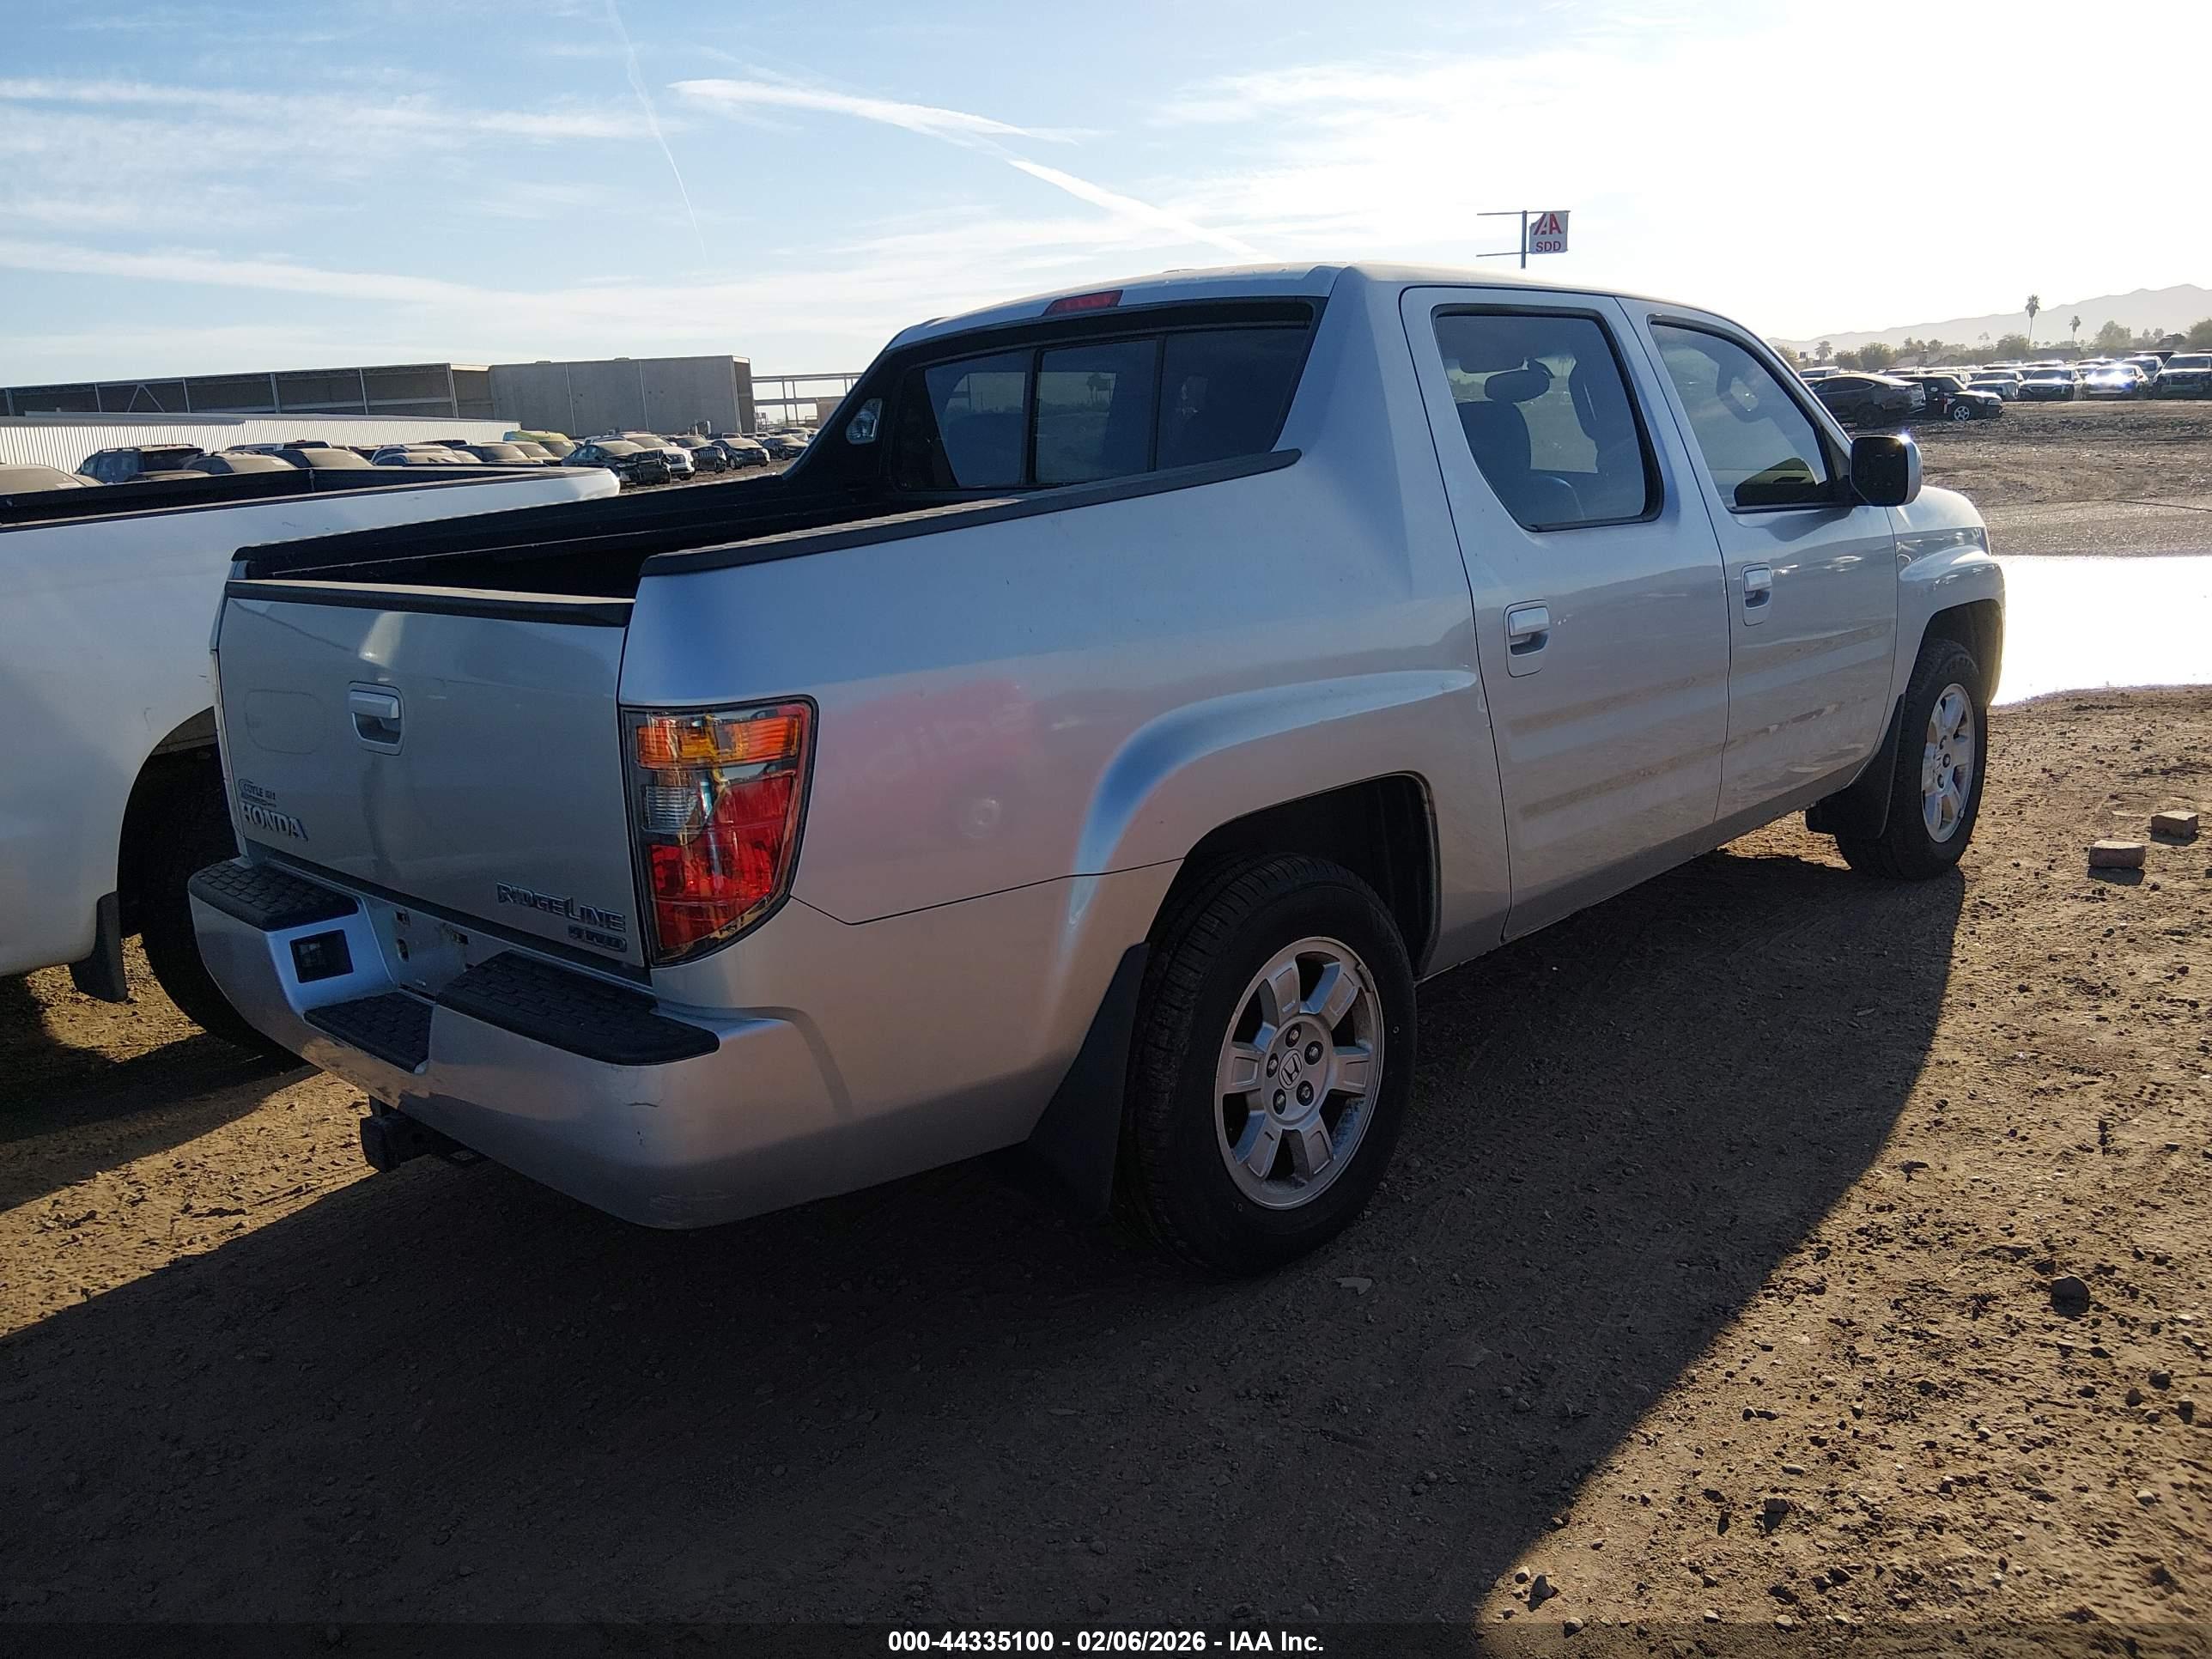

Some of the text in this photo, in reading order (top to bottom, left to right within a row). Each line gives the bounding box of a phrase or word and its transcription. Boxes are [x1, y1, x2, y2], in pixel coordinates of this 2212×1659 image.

[1535, 240, 1561, 252] SDD
[240, 801, 308, 842] HONDA
[495, 882, 627, 933] RIDGELINE
